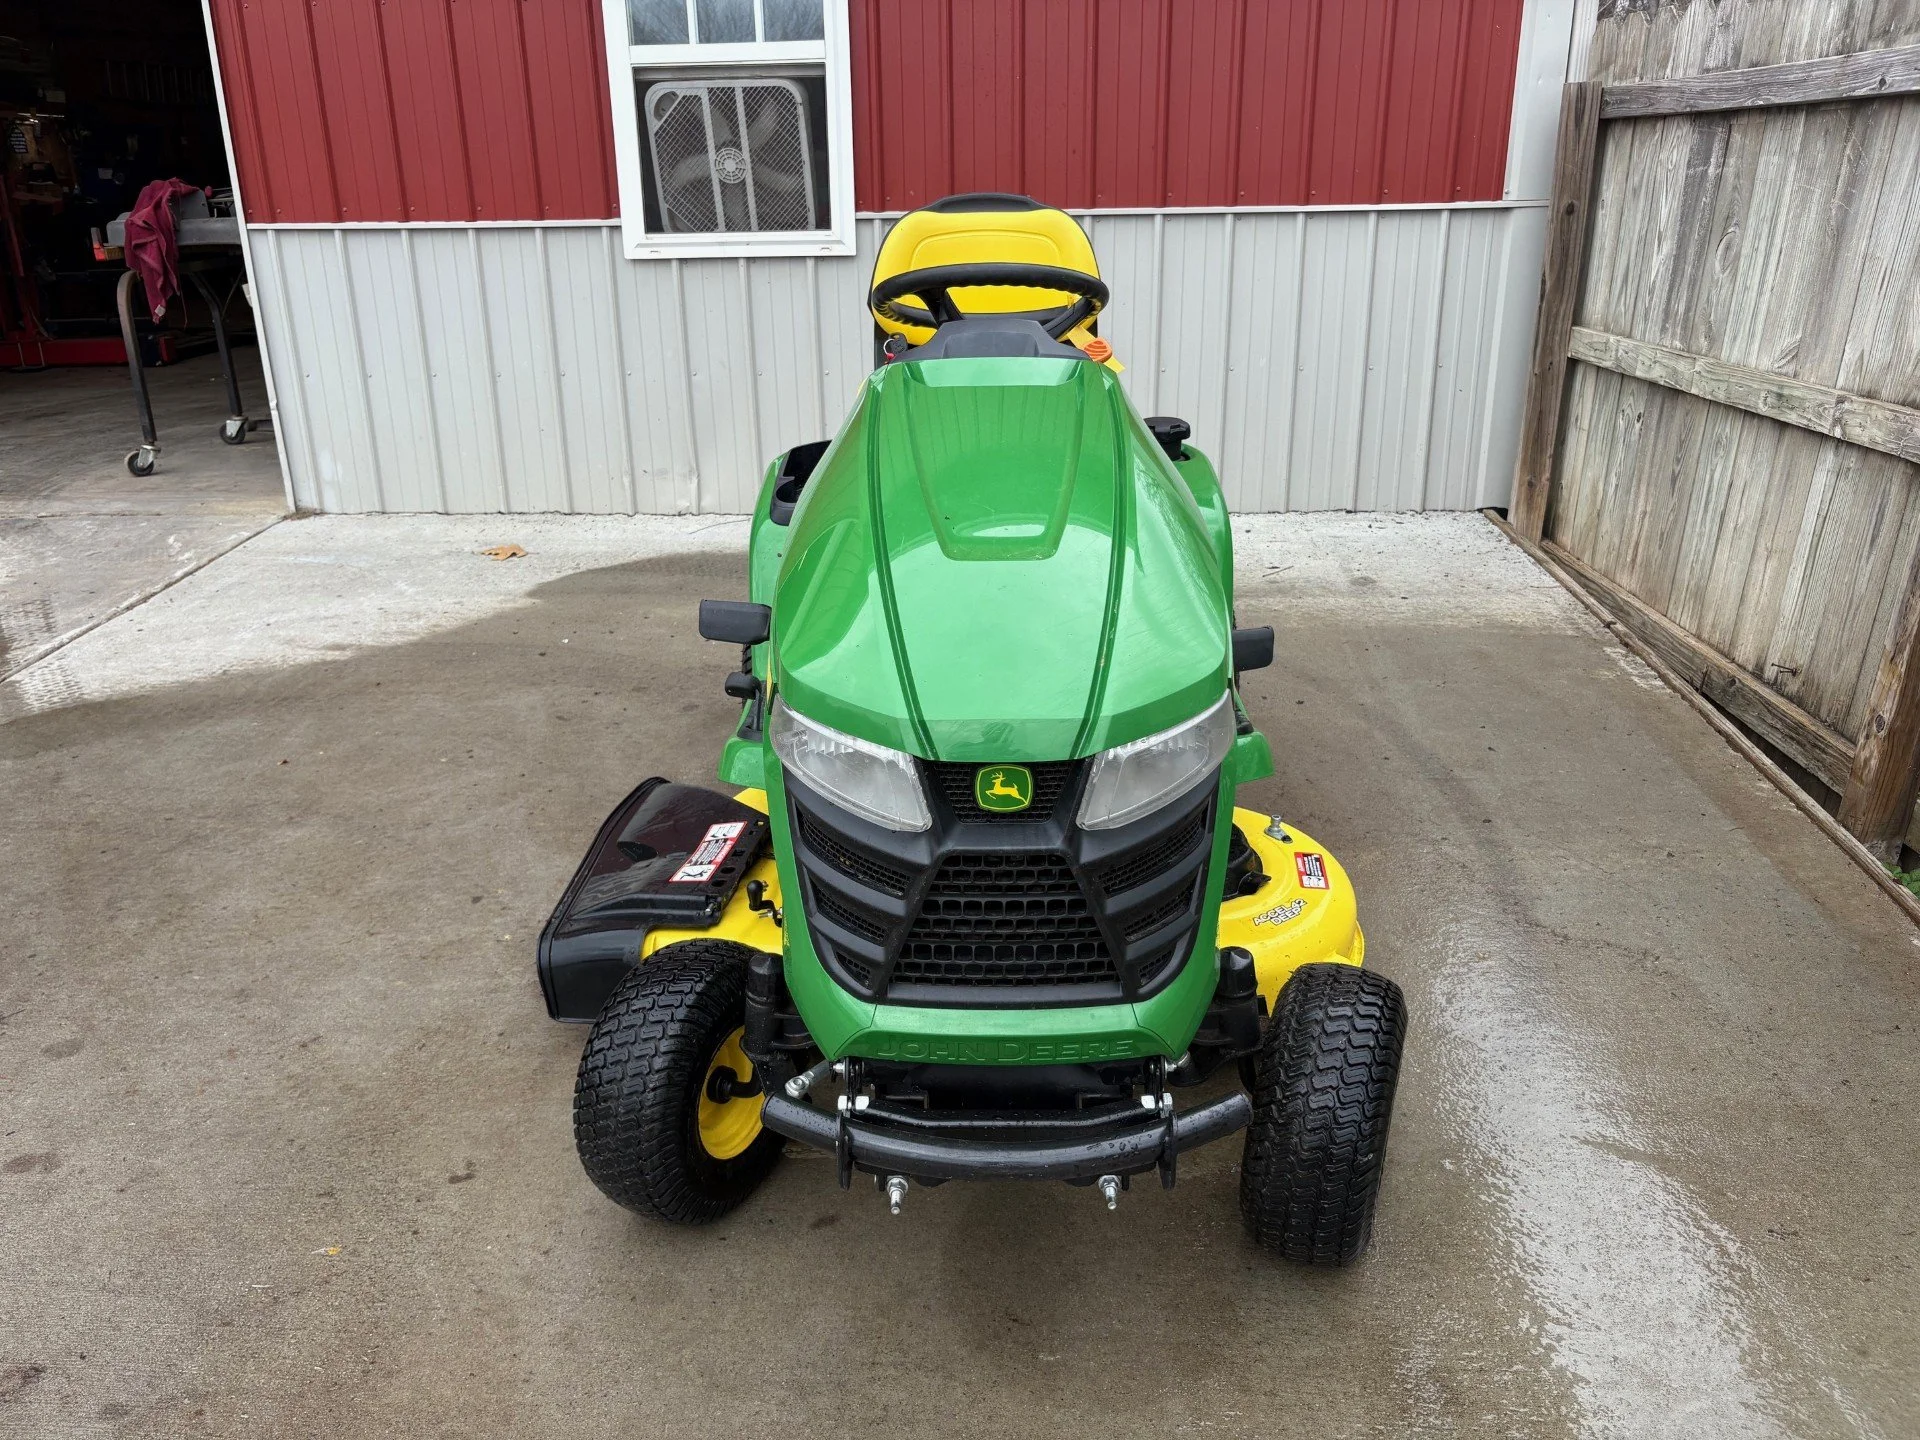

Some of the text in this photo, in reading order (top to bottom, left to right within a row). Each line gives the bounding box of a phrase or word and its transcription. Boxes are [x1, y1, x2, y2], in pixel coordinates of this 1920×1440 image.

[1253, 905, 1291, 926] ACCEL
[1270, 907, 1302, 926] DEEP
[877, 1037, 1133, 1062] JOHN DEERE
